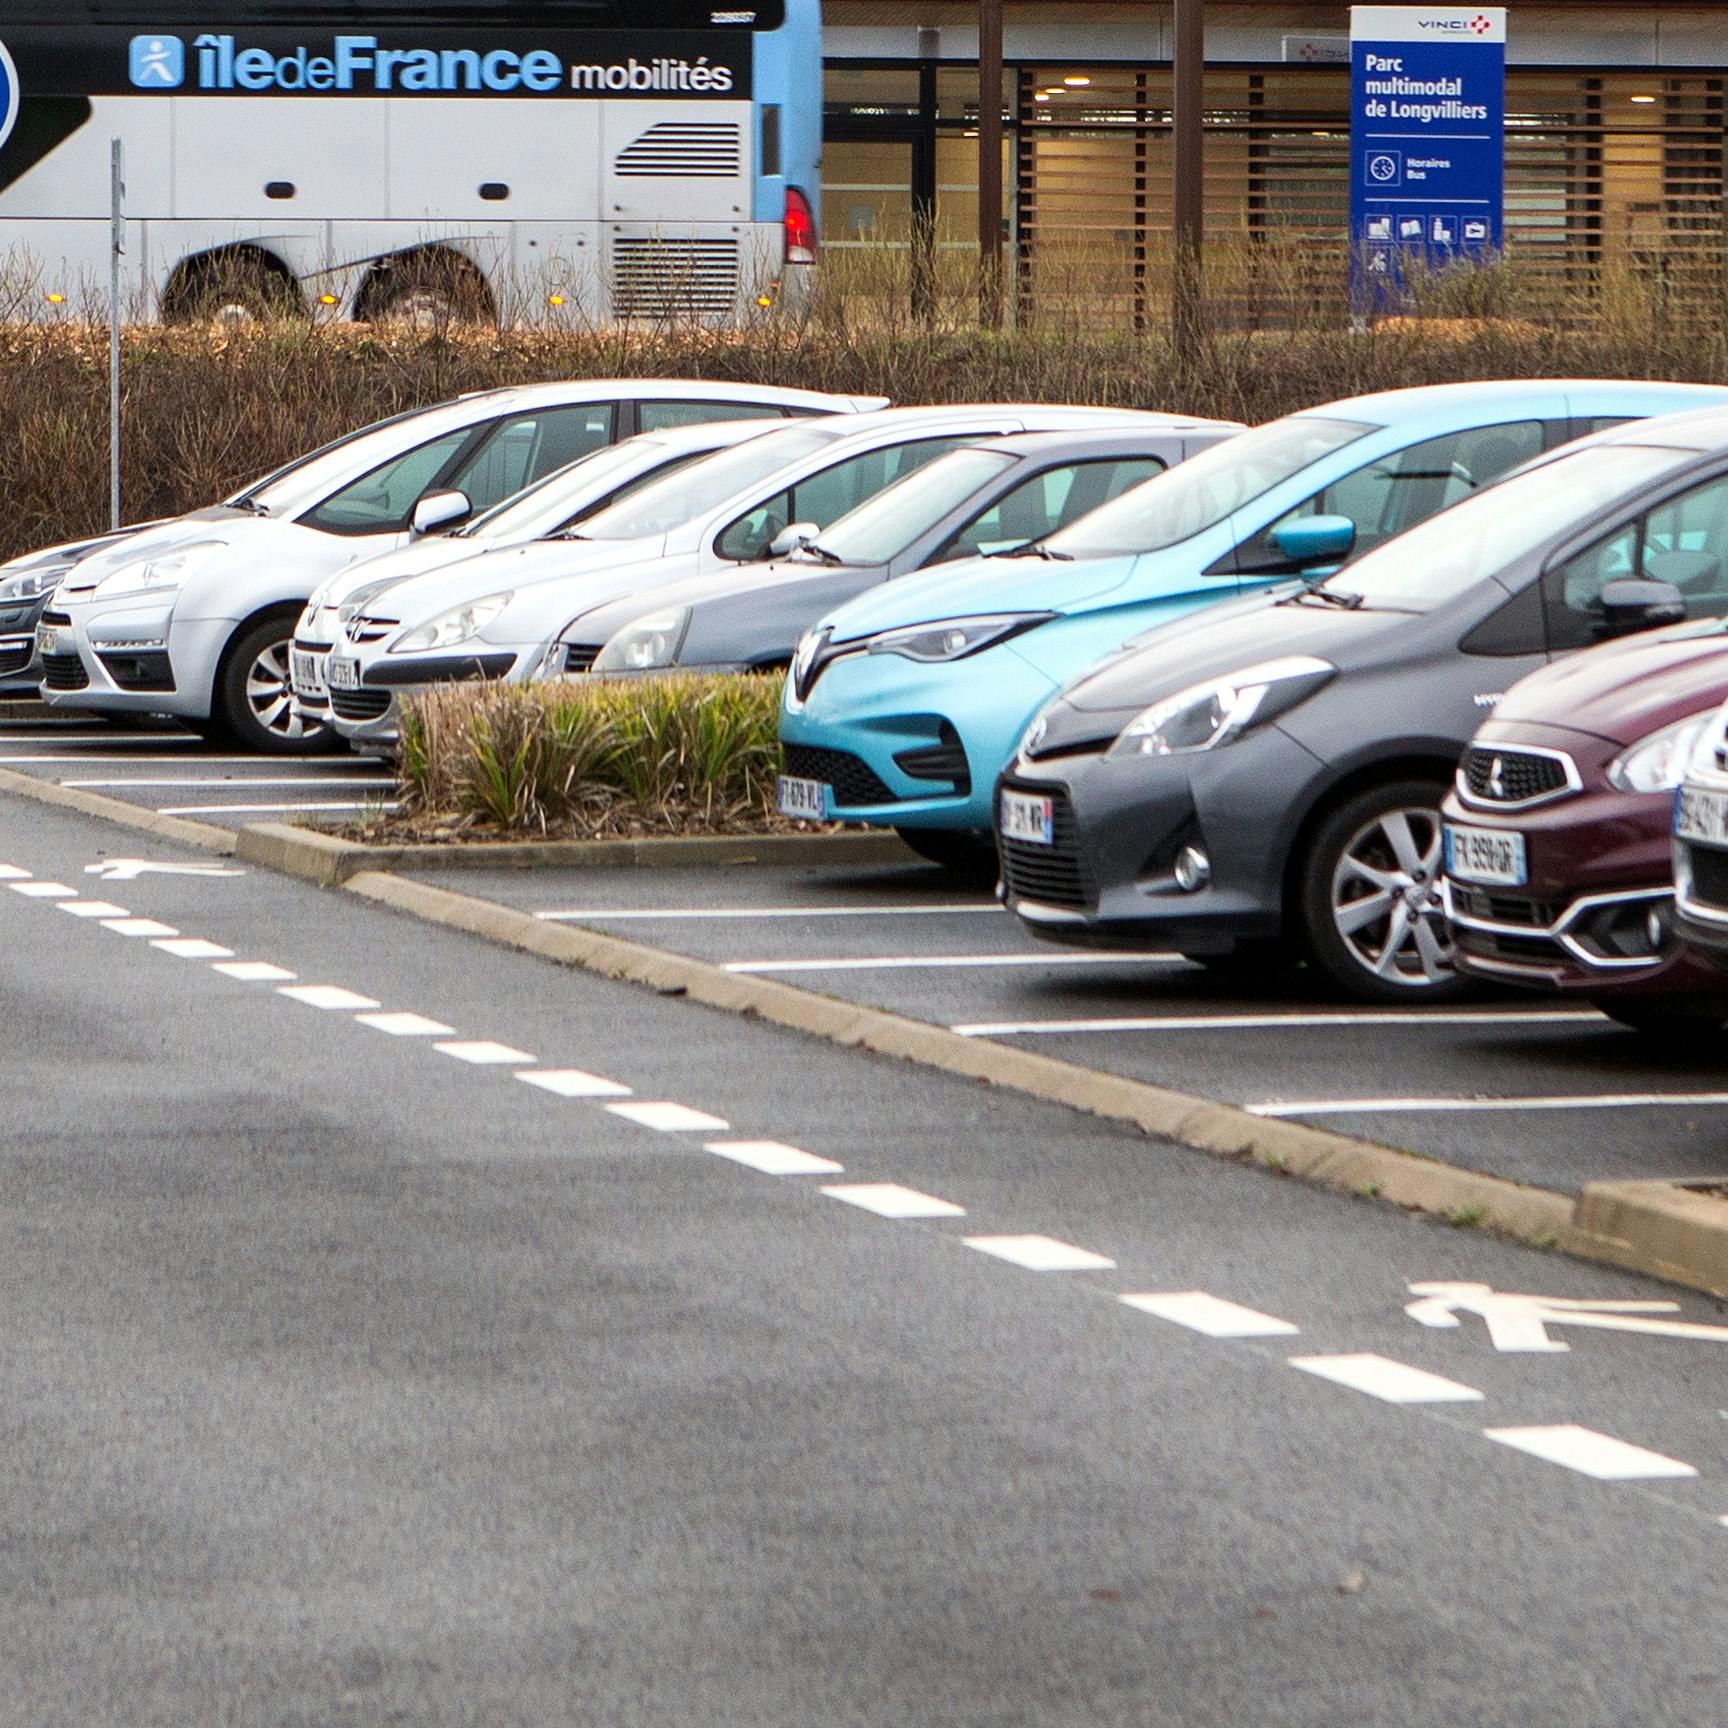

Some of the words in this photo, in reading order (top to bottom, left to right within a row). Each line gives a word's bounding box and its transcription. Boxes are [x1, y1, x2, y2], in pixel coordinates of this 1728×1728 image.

[1418, 20, 1467, 29] VINCI
[1365, 54, 1403, 72] Parc
[571, 56, 733, 92] mobilités
[1365, 76, 1462, 96] multimodal
[1365, 99, 1387, 118] de
[1390, 100, 1487, 123] Longvilliers
[1407, 158, 1451, 169] Horaires
[1406, 169, 1427, 180] Bus
